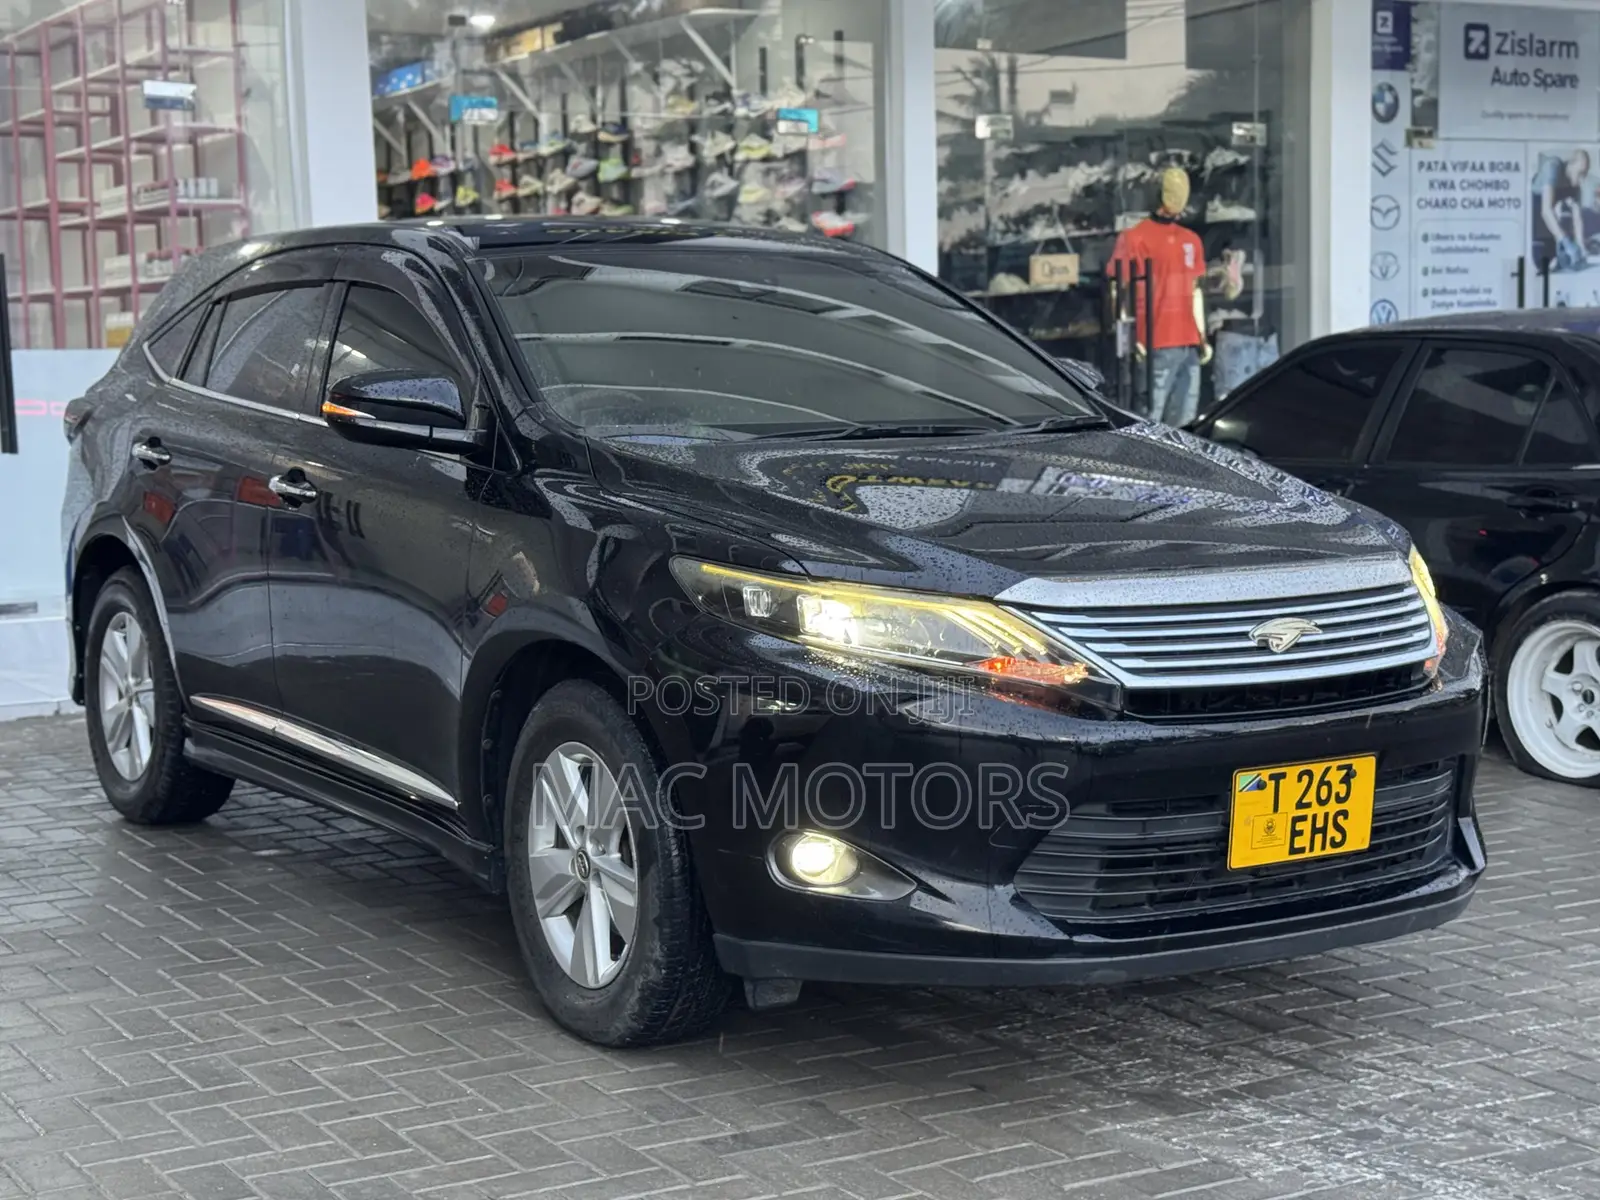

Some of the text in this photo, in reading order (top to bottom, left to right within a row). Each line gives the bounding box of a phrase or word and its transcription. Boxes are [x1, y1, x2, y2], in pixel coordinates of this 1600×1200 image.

[1495, 31, 1579, 59] Zislarm
[1491, 67, 1579, 91] Auto Spare
[1418, 161, 1521, 173] PATA VIFAA BORA
[1428, 179, 1510, 191] KWA CHOMBO
[1417, 197, 1521, 210] CHAKO CHA MOTO
[1268, 764, 1354, 814] T 263
[1288, 809, 1349, 856] EHS
